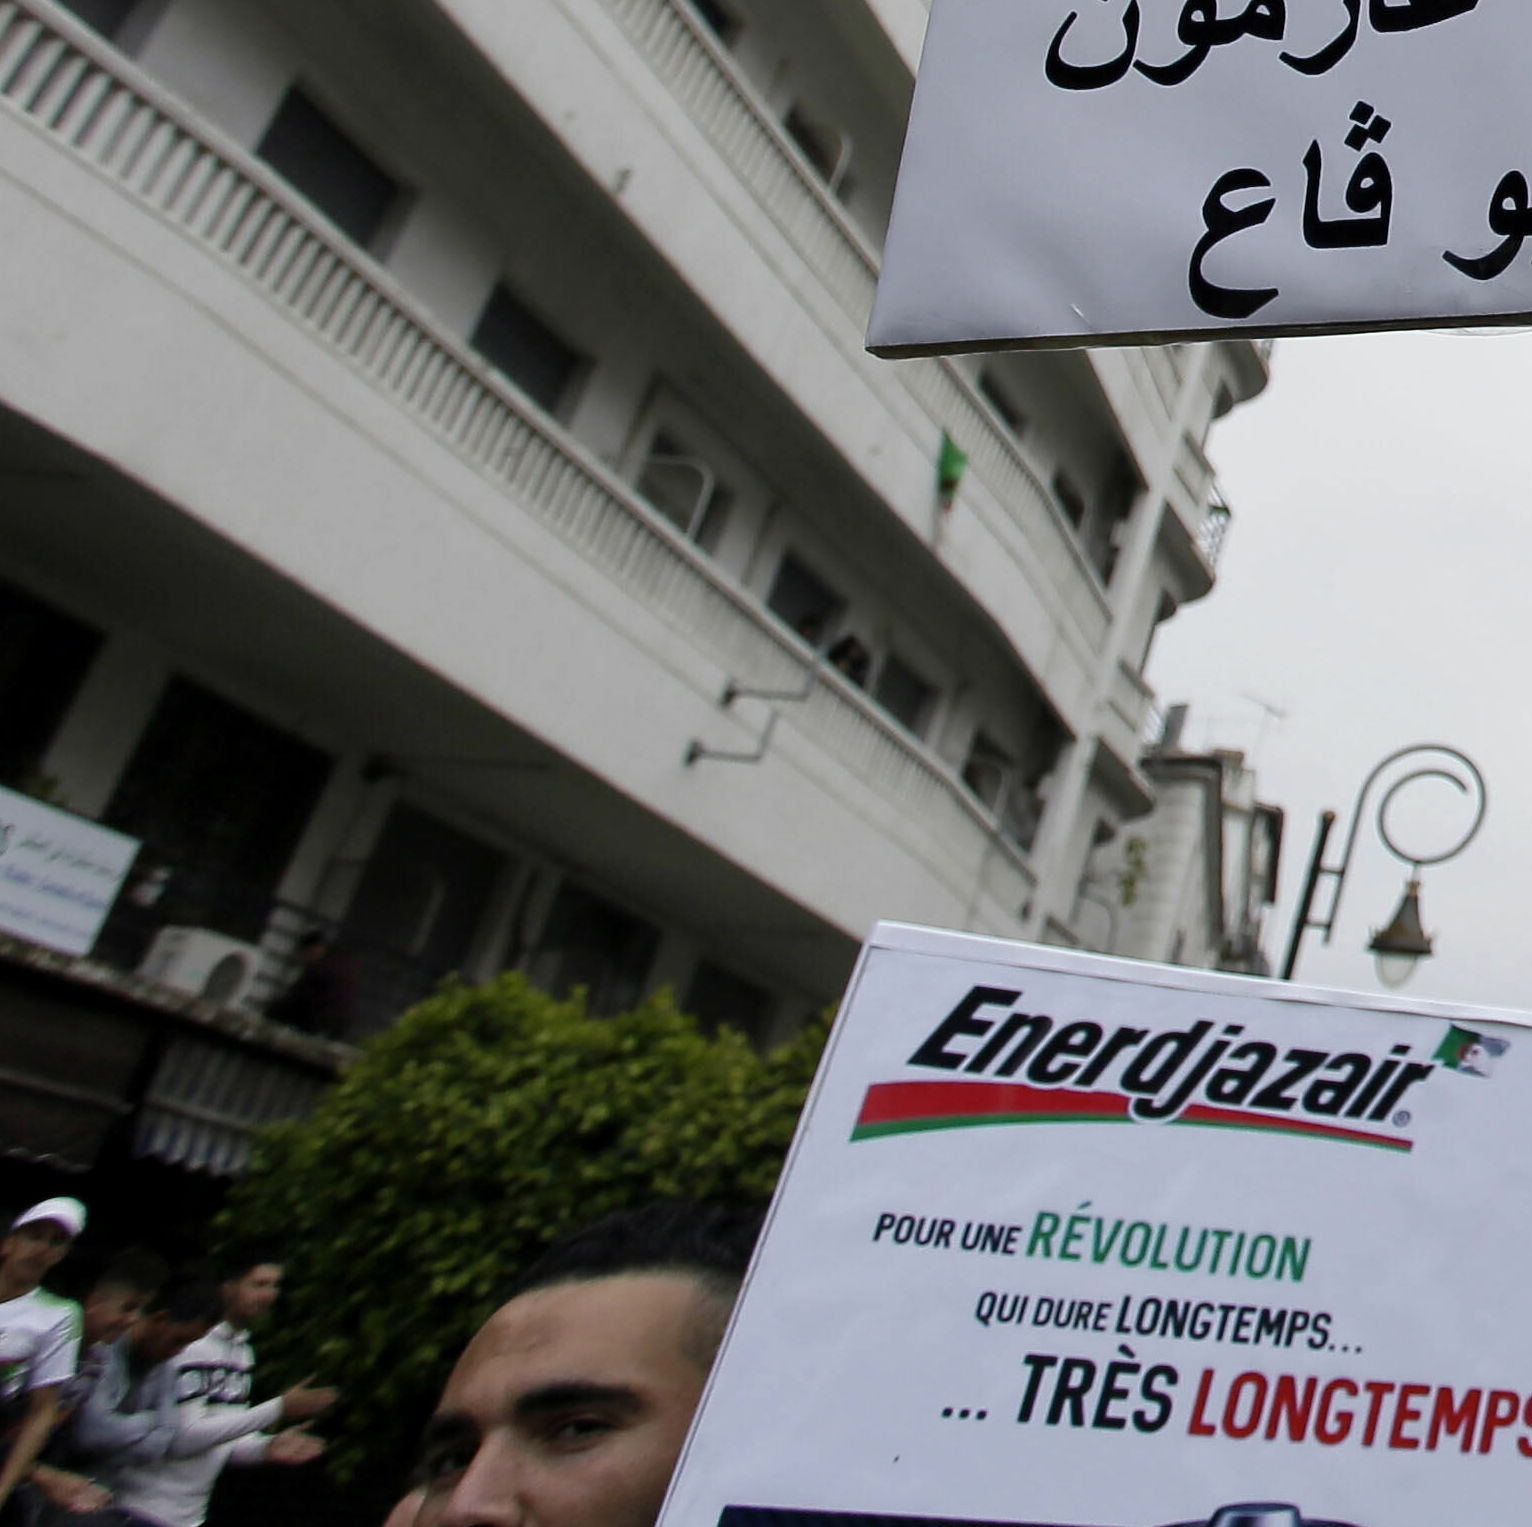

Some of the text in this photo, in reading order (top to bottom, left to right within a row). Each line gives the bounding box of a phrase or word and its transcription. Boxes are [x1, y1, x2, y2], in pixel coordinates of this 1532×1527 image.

[907, 984, 1436, 1122] Enerdjazair
[872, 1200, 1312, 1285] POUR UNE RÉVOLUTION
[974, 1290, 1030, 1328] QUI
[1031, 1296, 1113, 1334] DURE
[1015, 1343, 1181, 1436] TRÈS
